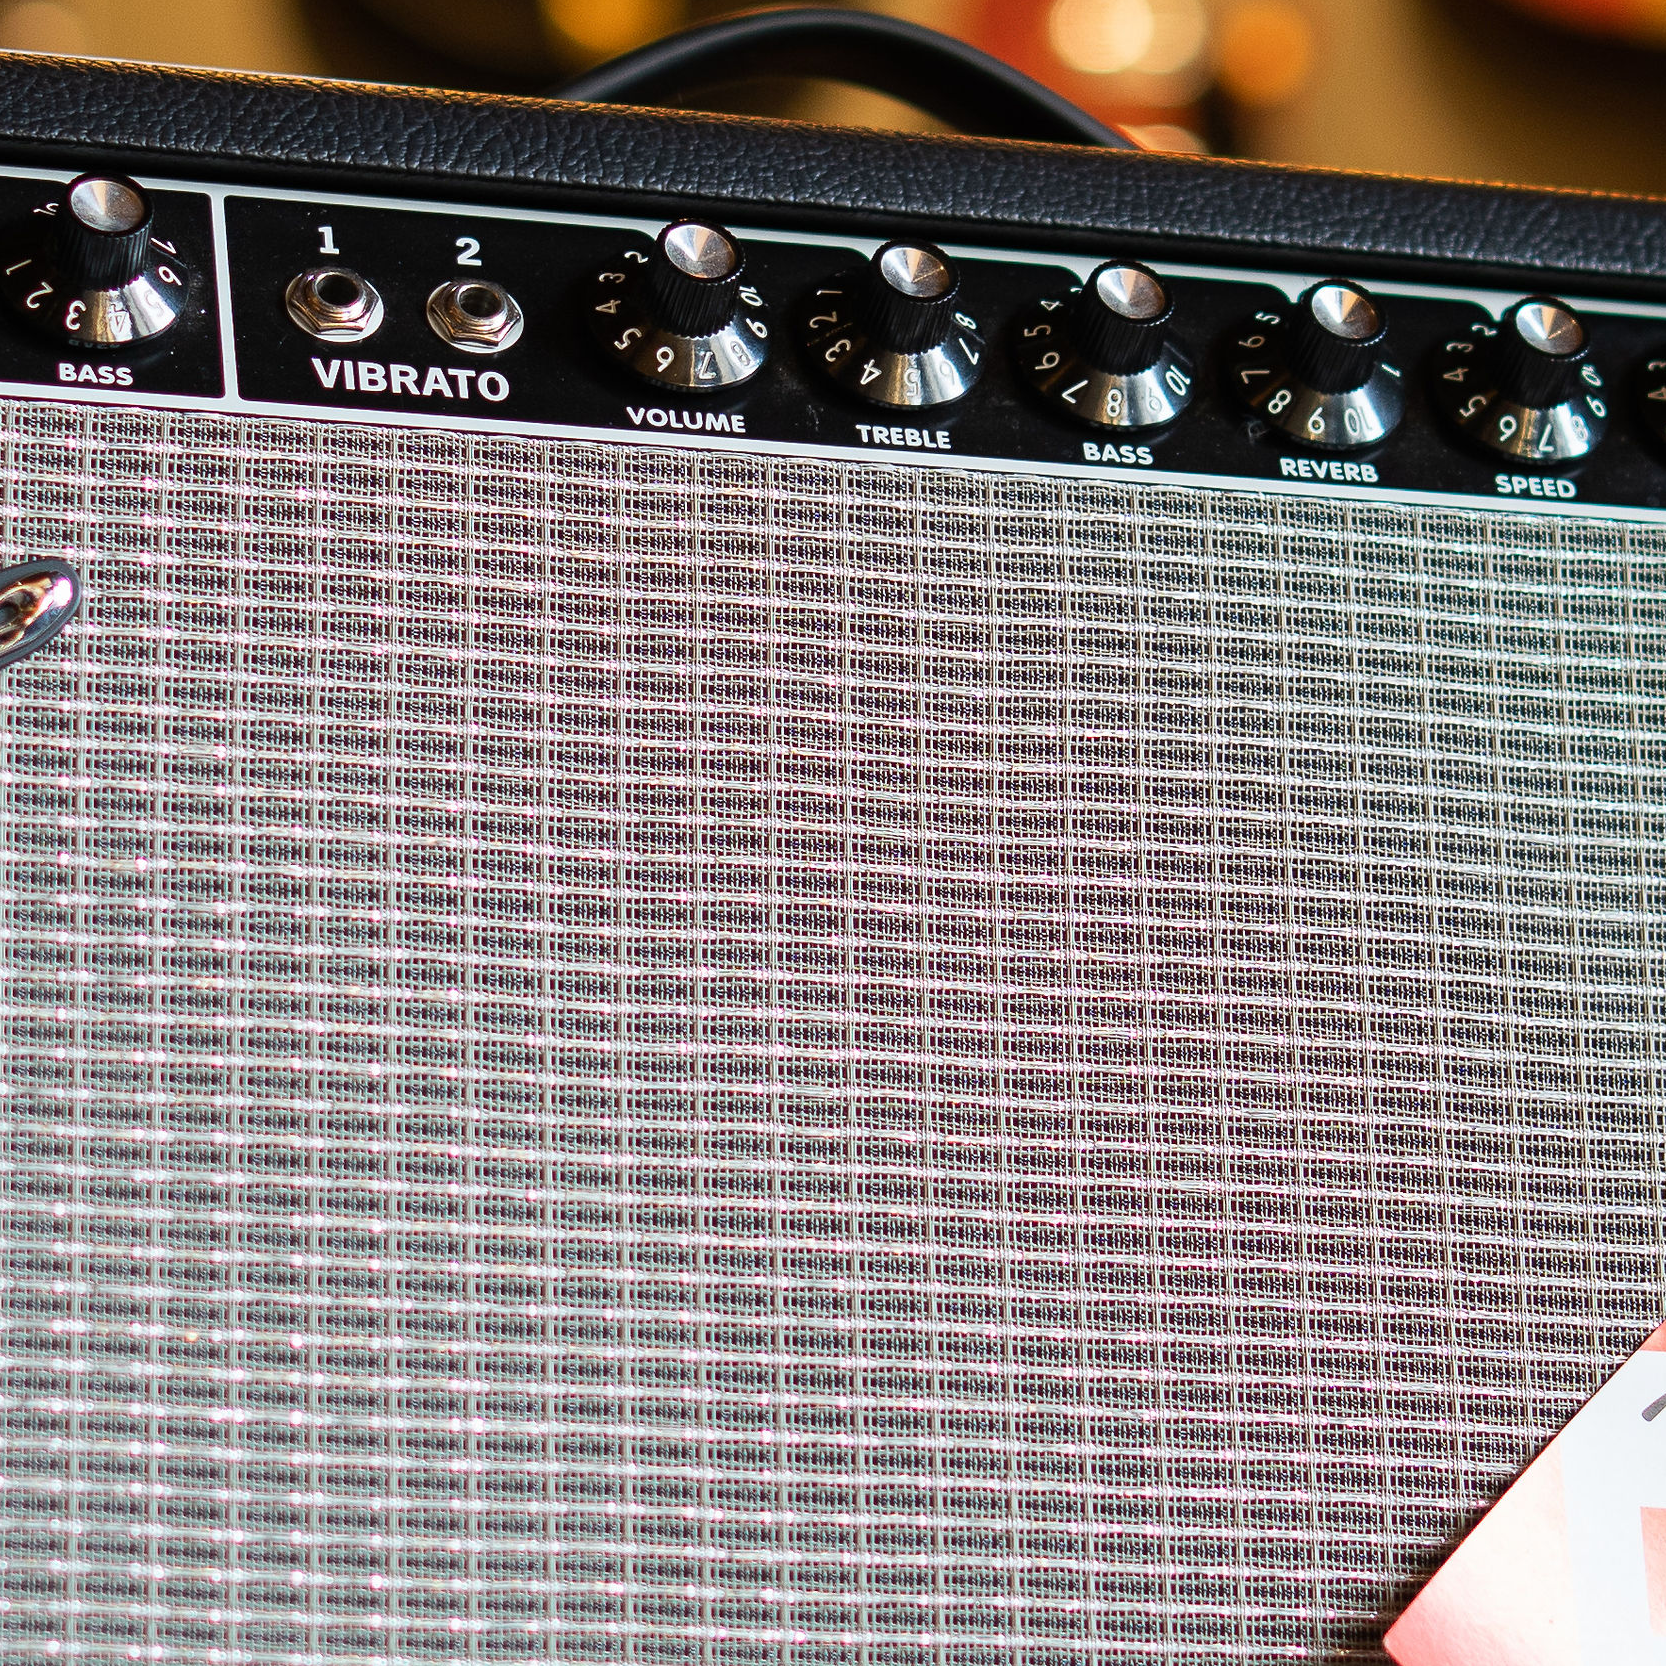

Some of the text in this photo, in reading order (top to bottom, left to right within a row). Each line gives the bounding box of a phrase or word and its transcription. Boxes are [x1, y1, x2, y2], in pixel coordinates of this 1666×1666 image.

[318, 226, 340, 254] 1
[455, 238, 482, 266] 2
[624, 251, 649, 264] 2
[6, 259, 32, 276] 1
[26, 282, 54, 309] 2
[66, 300, 87, 331] 3
[108, 299, 129, 332] 4
[150, 237, 177, 254] 7
[598, 272, 626, 284] 3
[595, 299, 621, 314] 4
[739, 285, 763, 307] 10
[1040, 300, 1064, 311] 4
[809, 311, 837, 329] 2
[955, 312, 977, 330] 8
[1255, 311, 1281, 325] 5
[1472, 324, 1497, 336] 2
[614, 328, 642, 350] 5
[1024, 325, 1051, 337] 5
[825, 339, 851, 363] 3
[958, 338, 979, 366] 7
[1446, 342, 1474, 353] 3
[58, 363, 133, 386] BASS
[698, 351, 717, 380] 7
[860, 359, 882, 385] 4
[1241, 369, 1270, 384] 7
[1443, 368, 1469, 382] 4
[311, 356, 511, 402] VIBRATO
[903, 368, 921, 397] 5
[1165, 365, 1191, 396] 10
[1061, 380, 1089, 404] 7
[1107, 389, 1123, 418] 8
[1268, 389, 1292, 414] 8
[1459, 395, 1487, 417] 5
[626, 406, 746, 433] VOLUME
[1344, 407, 1373, 436] 10
[1572, 415, 1589, 442] 8
[855, 424, 952, 449] TREBLE
[1538, 423, 1554, 452] 7
[1083, 442, 1154, 465] BASS
[1279, 457, 1379, 483] REVERB
[1495, 473, 1576, 498] SPEED
